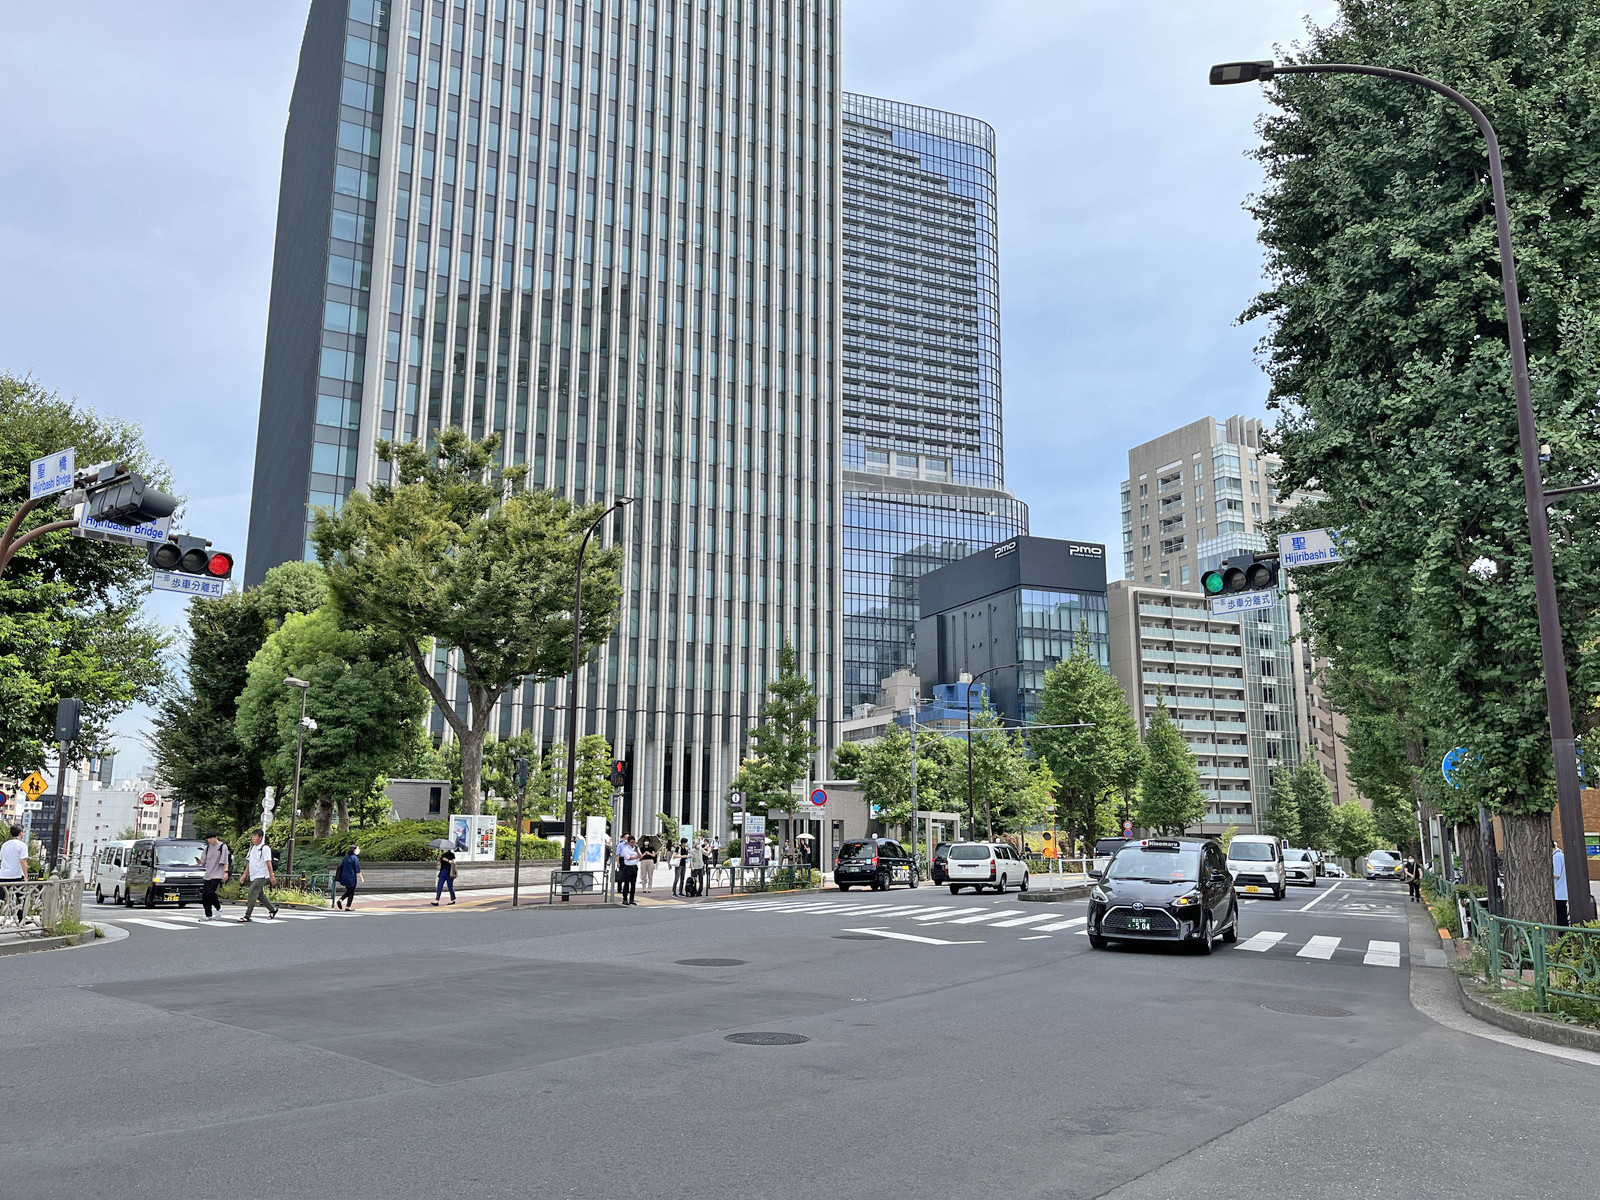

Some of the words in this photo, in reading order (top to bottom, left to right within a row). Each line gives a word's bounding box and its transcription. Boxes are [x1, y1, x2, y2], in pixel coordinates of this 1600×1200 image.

[33, 477, 55, 494] Hijiribashi
[56, 474, 71, 486] Bridge
[134, 523, 164, 539] Bridge
[1285, 548, 1327, 564] Hijiribashi
